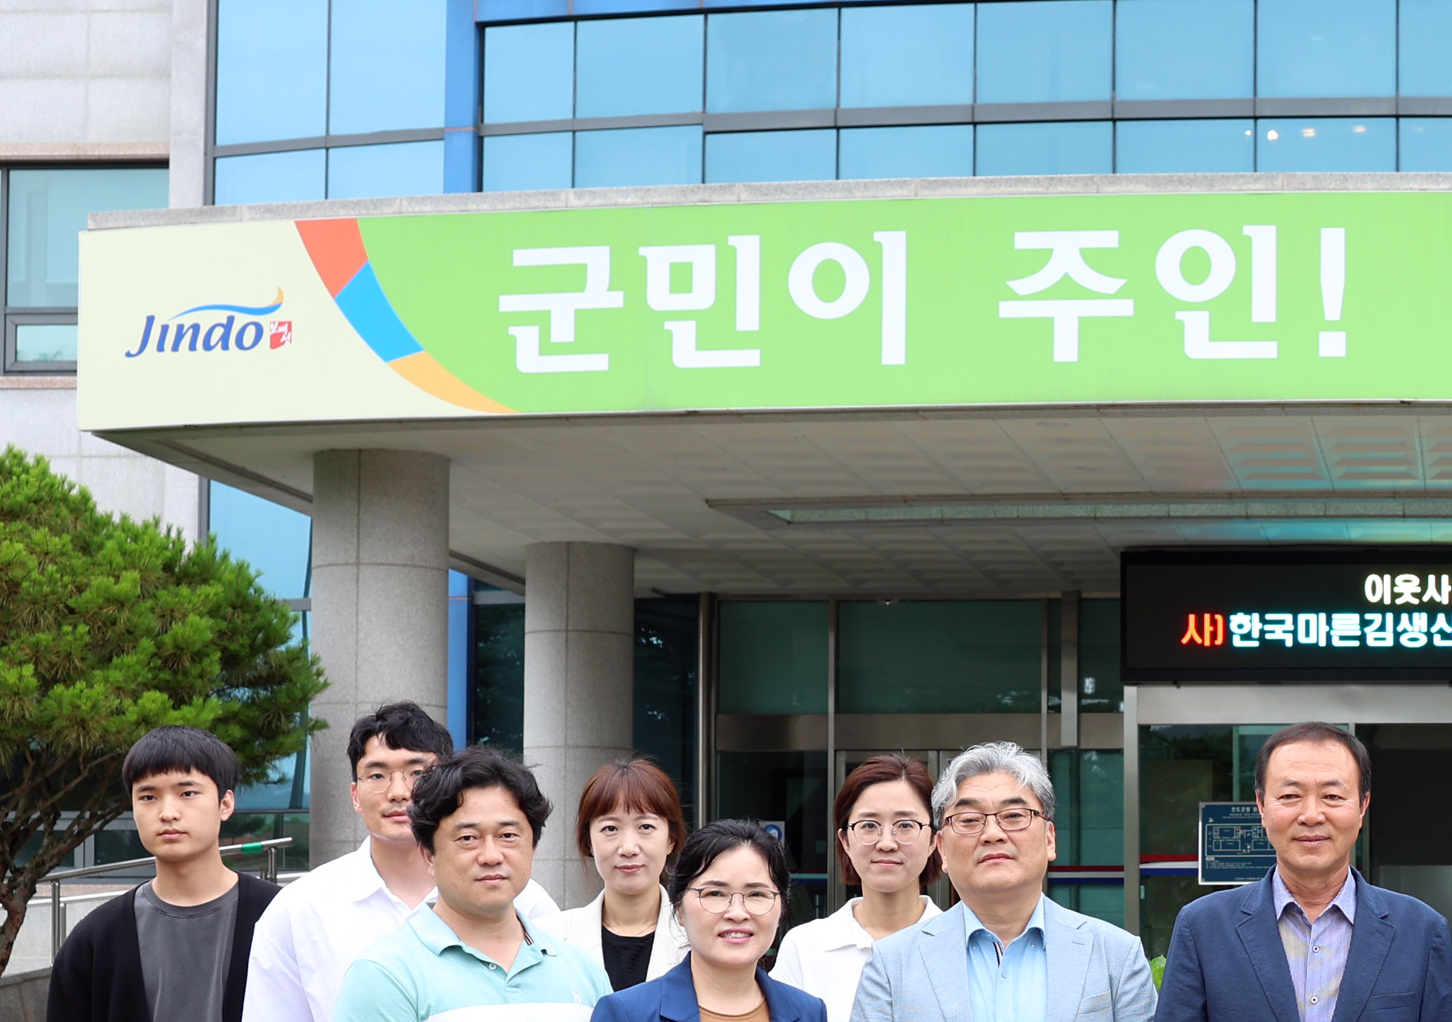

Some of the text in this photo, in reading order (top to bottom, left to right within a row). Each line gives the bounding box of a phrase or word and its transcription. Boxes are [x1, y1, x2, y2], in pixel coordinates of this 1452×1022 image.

[125, 315, 264, 358] Jindo
[499, 230, 907, 373] 군민이
[999, 224, 1347, 362] 주인!
